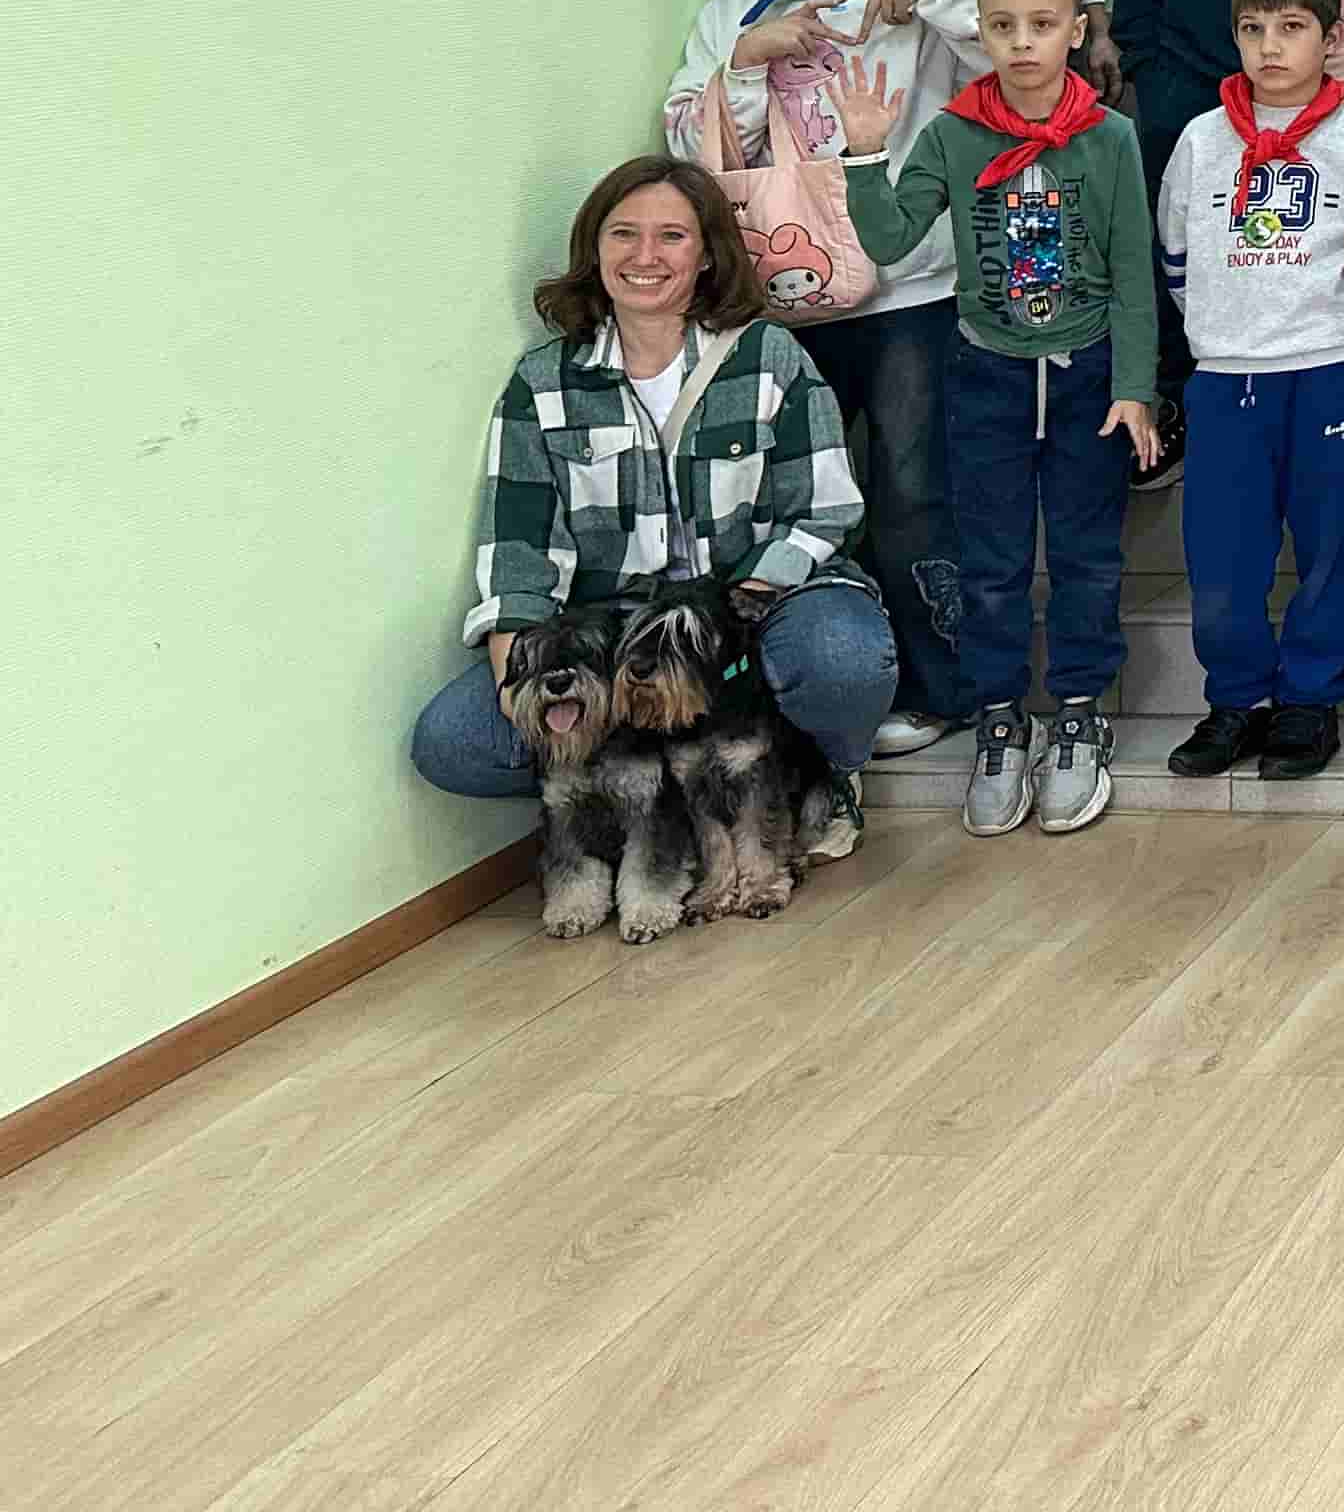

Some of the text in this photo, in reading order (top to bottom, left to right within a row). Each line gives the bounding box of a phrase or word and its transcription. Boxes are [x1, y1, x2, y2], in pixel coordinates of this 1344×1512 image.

[1229, 161, 1320, 232] 23
[1227, 251, 1312, 268] ENJOY & PLAY
